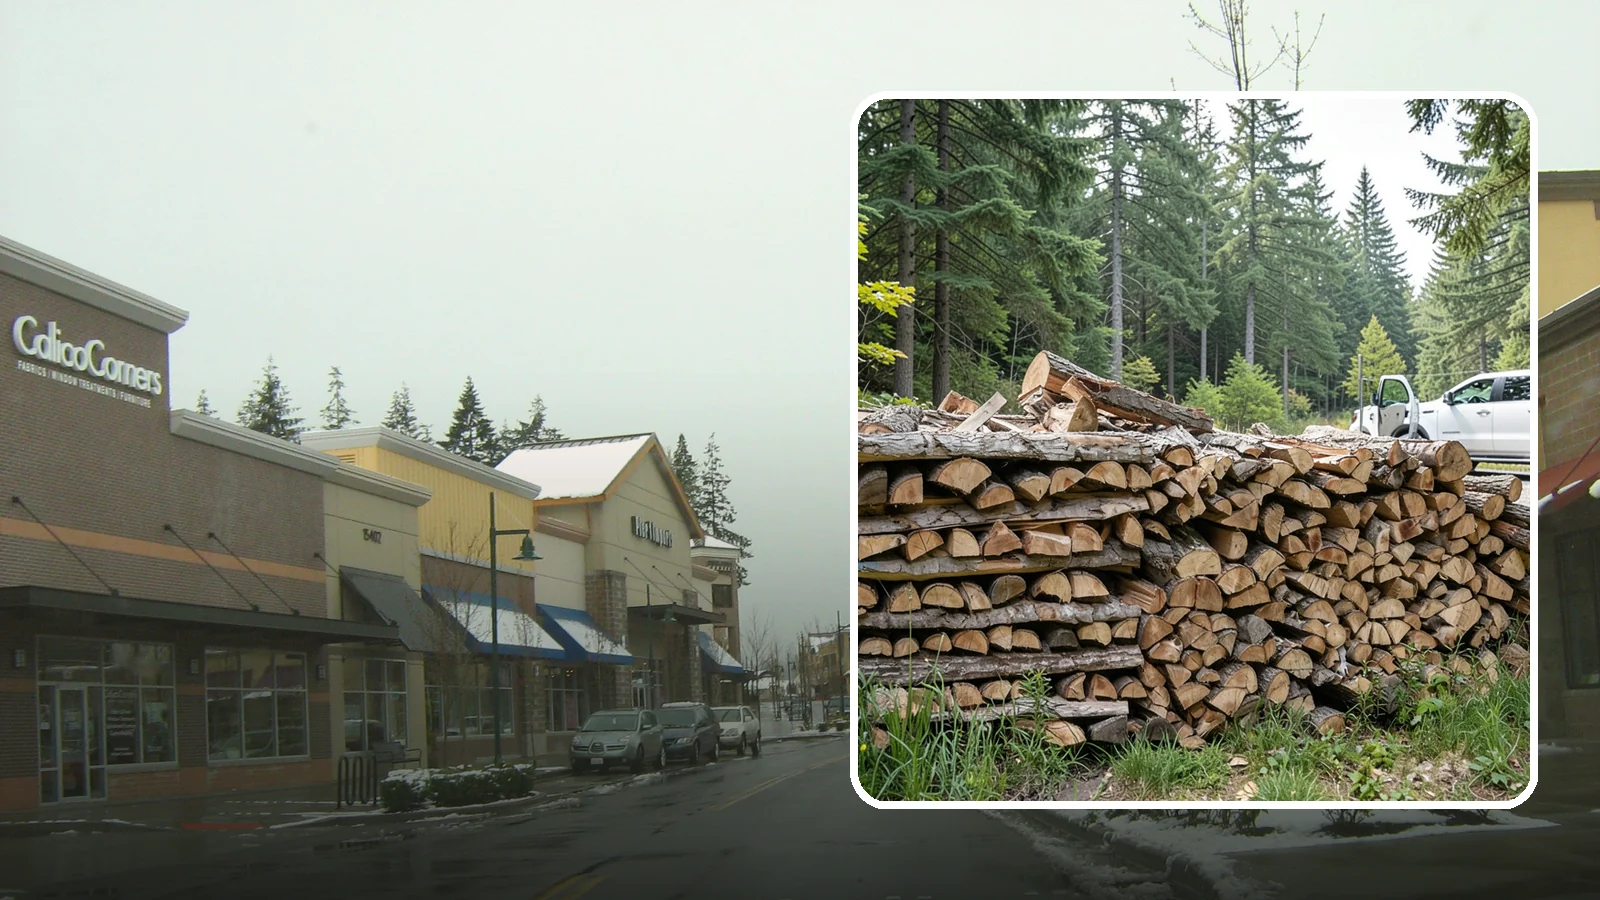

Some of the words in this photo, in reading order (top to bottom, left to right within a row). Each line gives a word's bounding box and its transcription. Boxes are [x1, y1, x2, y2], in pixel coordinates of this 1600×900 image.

[17, 360, 47, 377] FABRICS
[51, 370, 78, 387] WINDOW
[78, 378, 116, 399] TREATMENTS
[120, 391, 151, 408] FURNITURE
